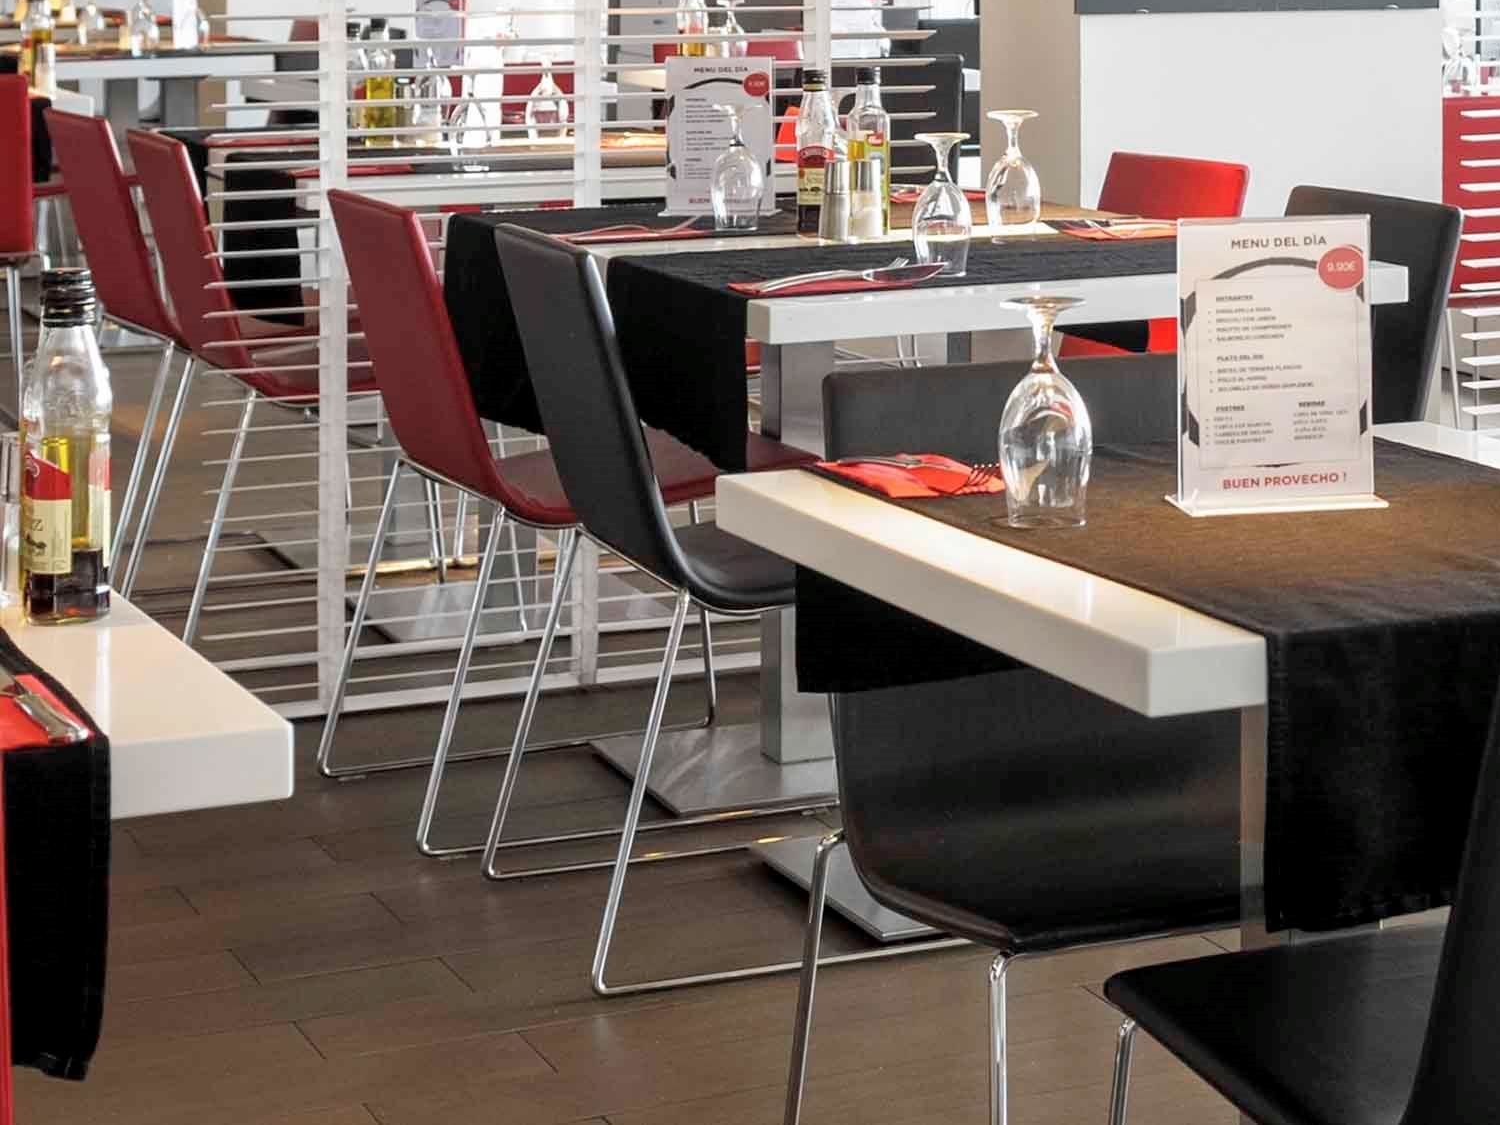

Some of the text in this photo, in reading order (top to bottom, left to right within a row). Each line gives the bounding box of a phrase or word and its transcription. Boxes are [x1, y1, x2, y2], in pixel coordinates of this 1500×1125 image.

[1231, 237, 1270, 249] MENU
[1274, 236, 1299, 248] DEL
[1222, 477, 1261, 490] BUEN
[1264, 472, 1340, 487] PROVECHO
